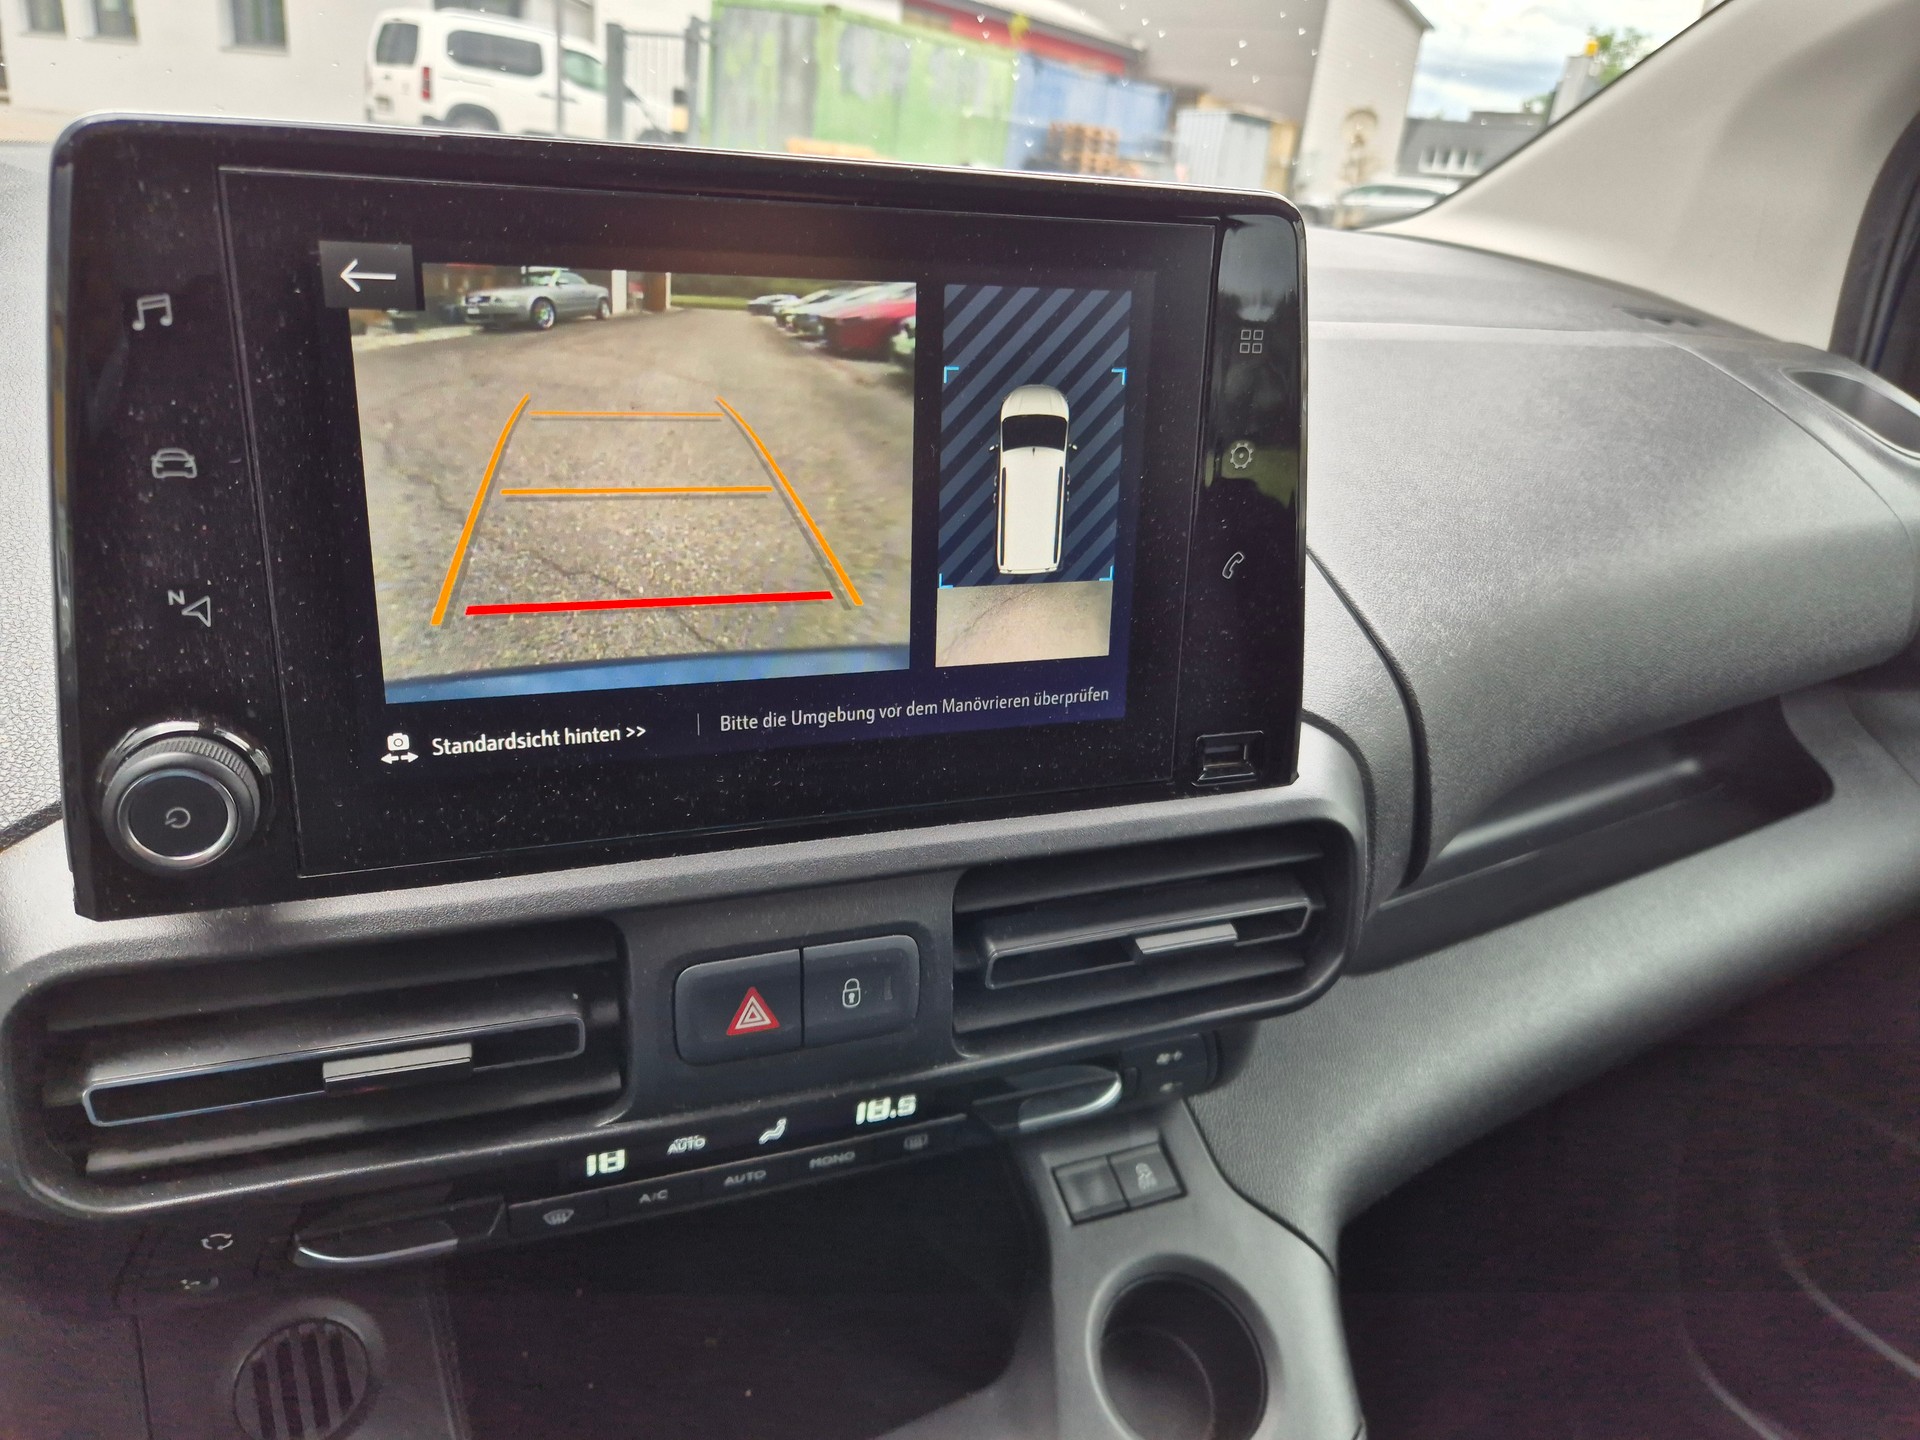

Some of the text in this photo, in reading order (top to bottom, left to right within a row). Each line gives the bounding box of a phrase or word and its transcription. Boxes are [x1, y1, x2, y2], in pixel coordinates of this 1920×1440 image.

[720, 686, 1109, 732] Bitte die Umgebung vor dem Manövrieren überprüfen
[431, 729, 561, 756] Standardsicht
[564, 727, 621, 745] hinten
[667, 1135, 706, 1156] AUTO
[586, 1149, 626, 1178] 18
[809, 1151, 856, 1169] MONO
[724, 1170, 767, 1187] AUTO
[639, 1189, 668, 1204] A/C
